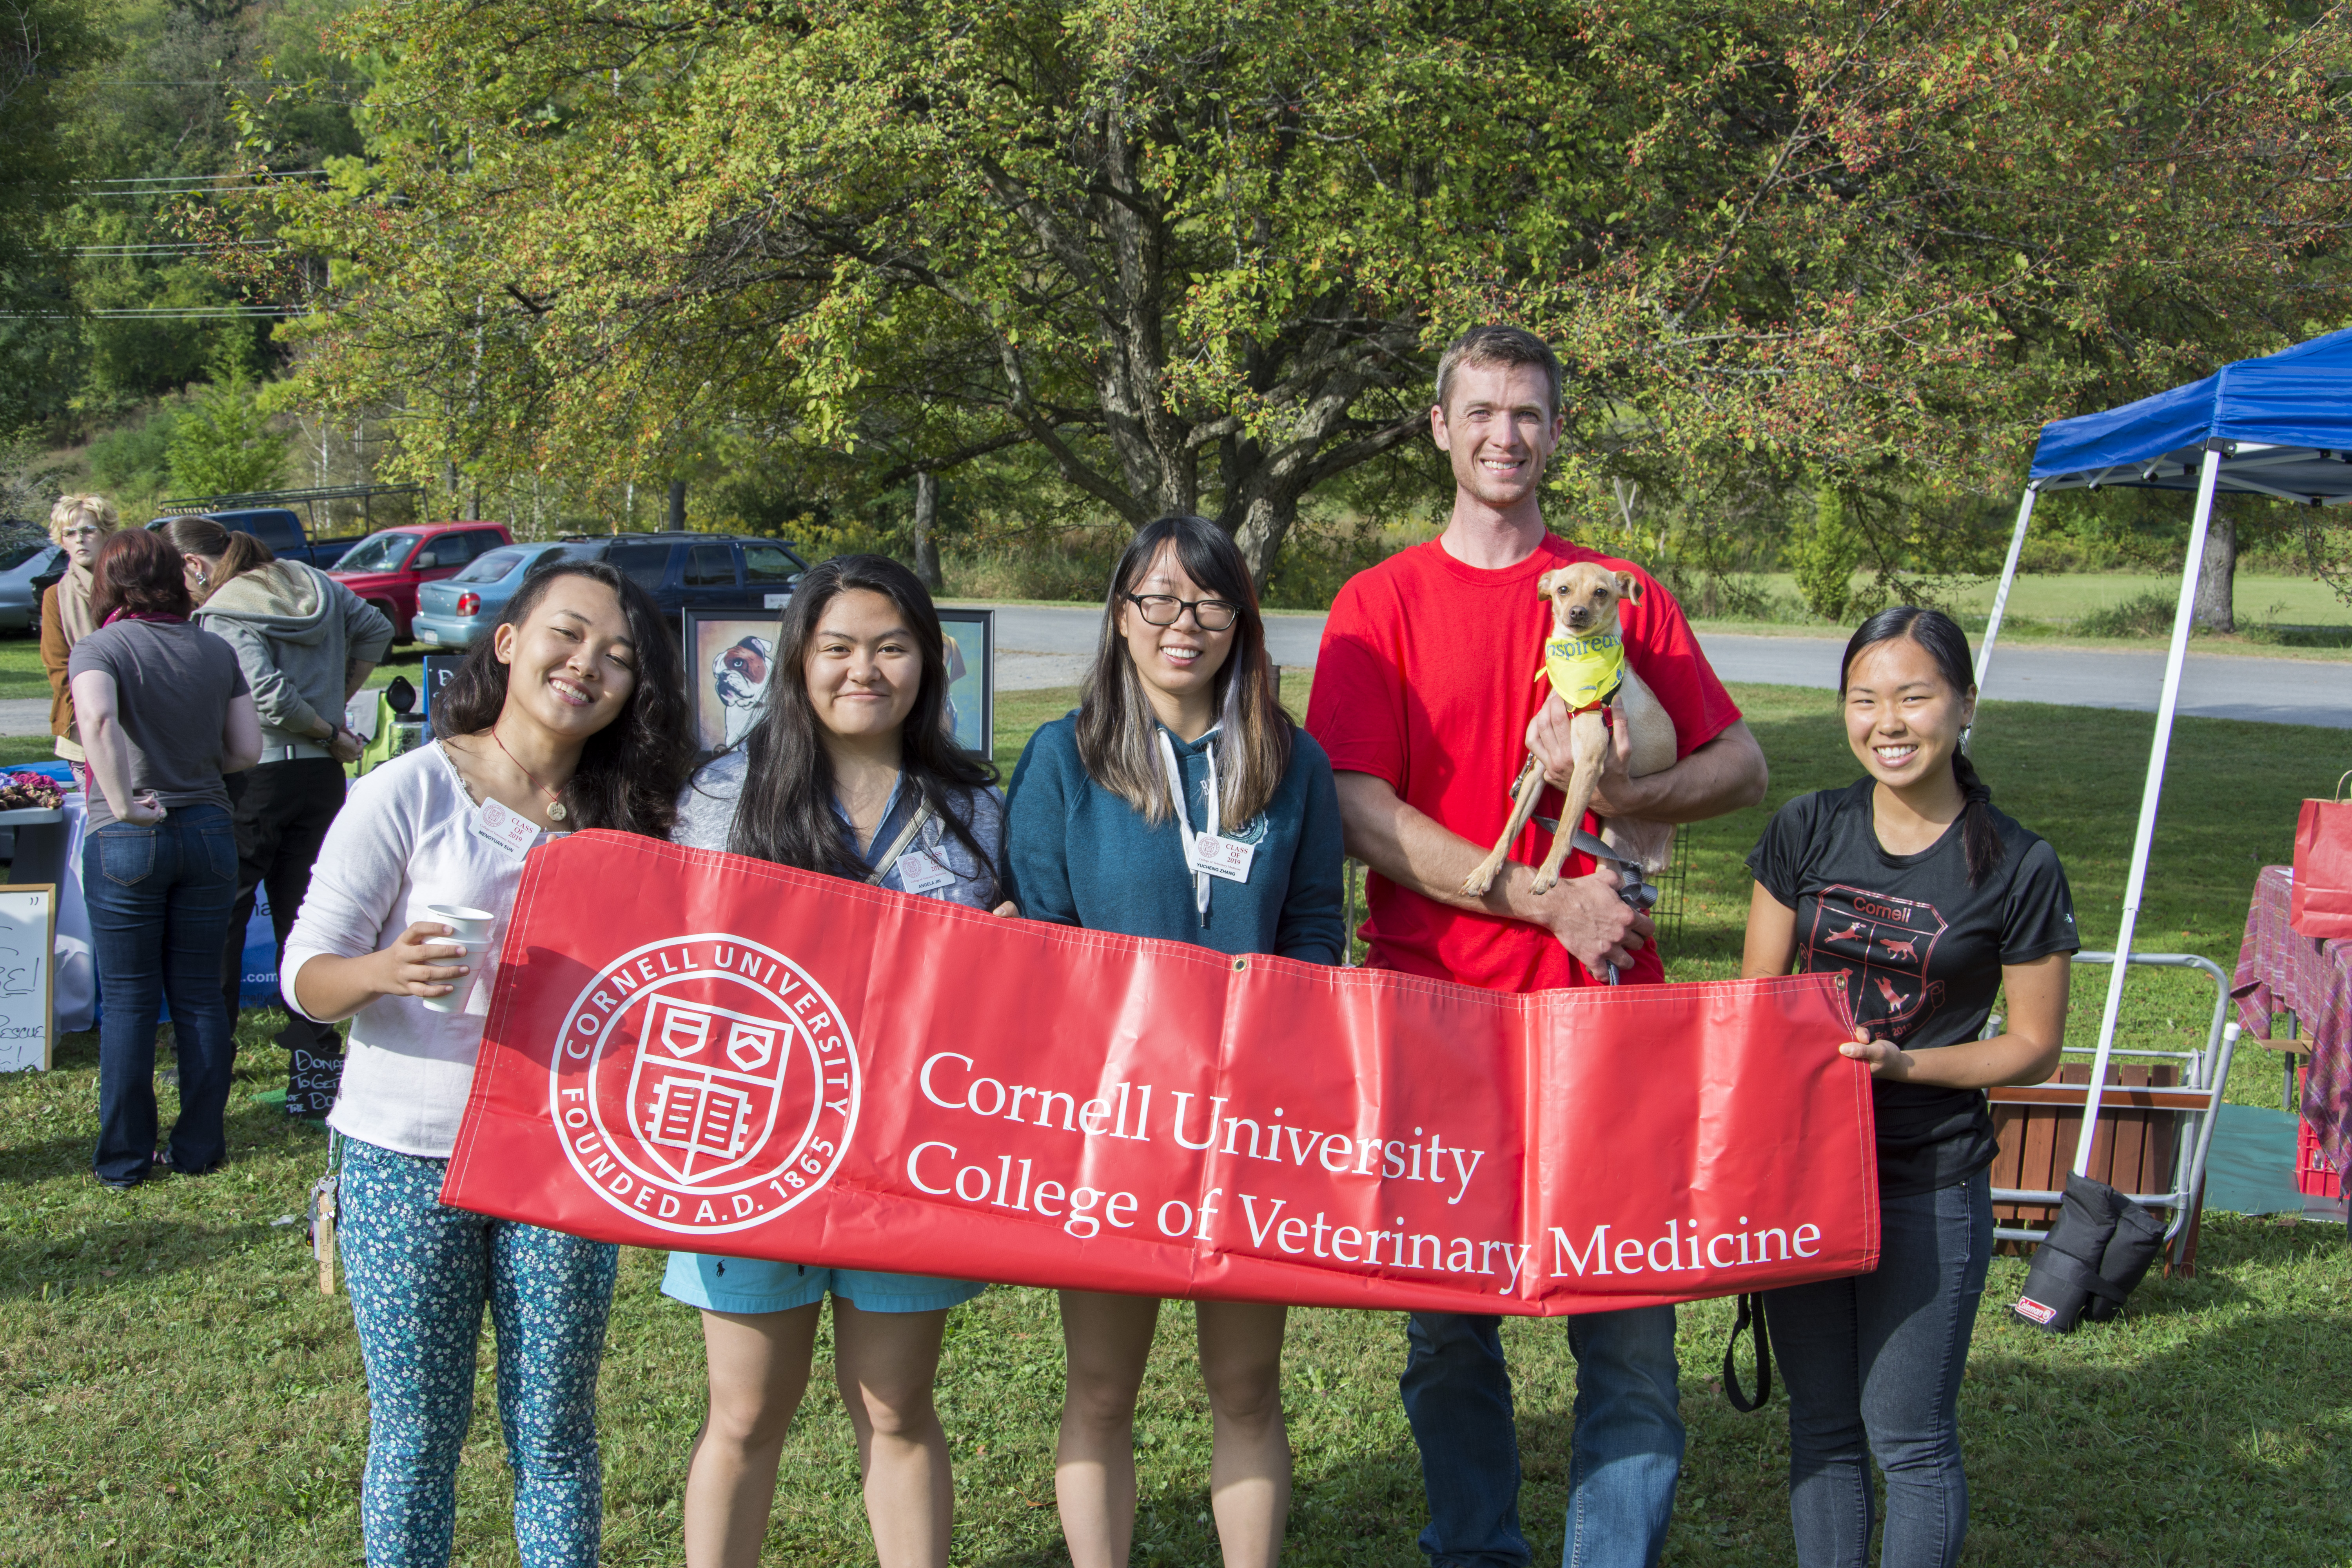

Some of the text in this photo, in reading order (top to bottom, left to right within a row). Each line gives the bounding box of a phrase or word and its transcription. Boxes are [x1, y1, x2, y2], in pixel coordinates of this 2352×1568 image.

[512, 818, 534, 833] CLASS
[478, 830, 504, 847] MENGYUAN
[508, 831, 523, 842] 2019
[508, 840, 520, 848] Medicine
[1226, 844, 1248, 854] CLASS
[1197, 863, 1219, 871] YUCHENG
[1853, 897, 1911, 923] Cornell
[566, 945, 849, 1116] CORNELL UNIVERSITY
[308, 1092, 337, 1110] DO
[920, 1052, 1485, 1205] Cornell University
[562, 1088, 834, 1223] FOUNDED A.D. 1865
[907, 1141, 1822, 1295] College of Veterinary Medicine
[2018, 1299, 2043, 1317] Coleman
